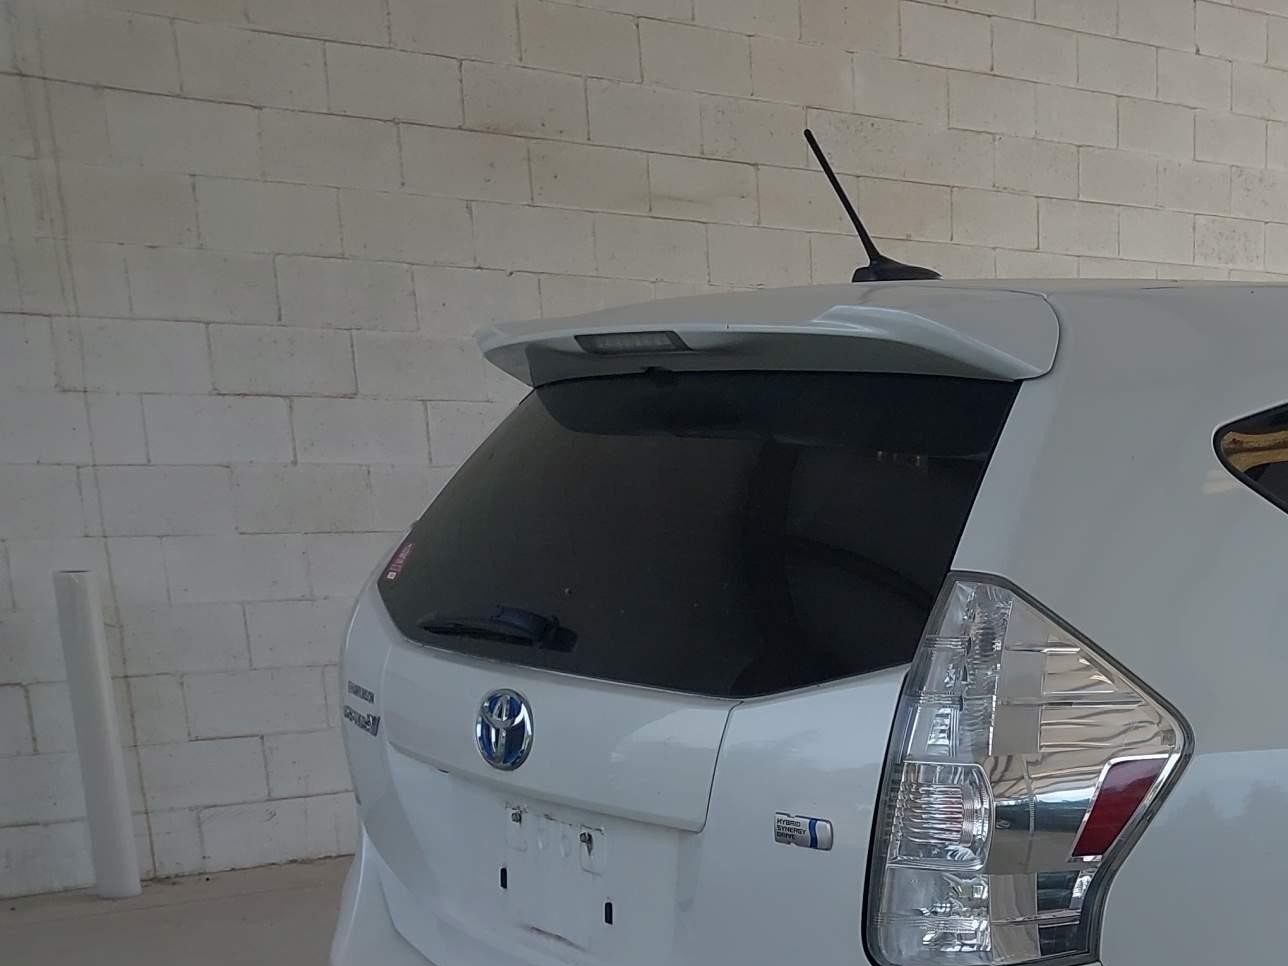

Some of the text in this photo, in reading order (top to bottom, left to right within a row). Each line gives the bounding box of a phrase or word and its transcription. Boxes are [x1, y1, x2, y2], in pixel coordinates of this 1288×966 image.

[777, 818, 801, 827] HYBRID
[777, 825, 807, 835] SYNERGY
[777, 832, 796, 840] DRIVE
